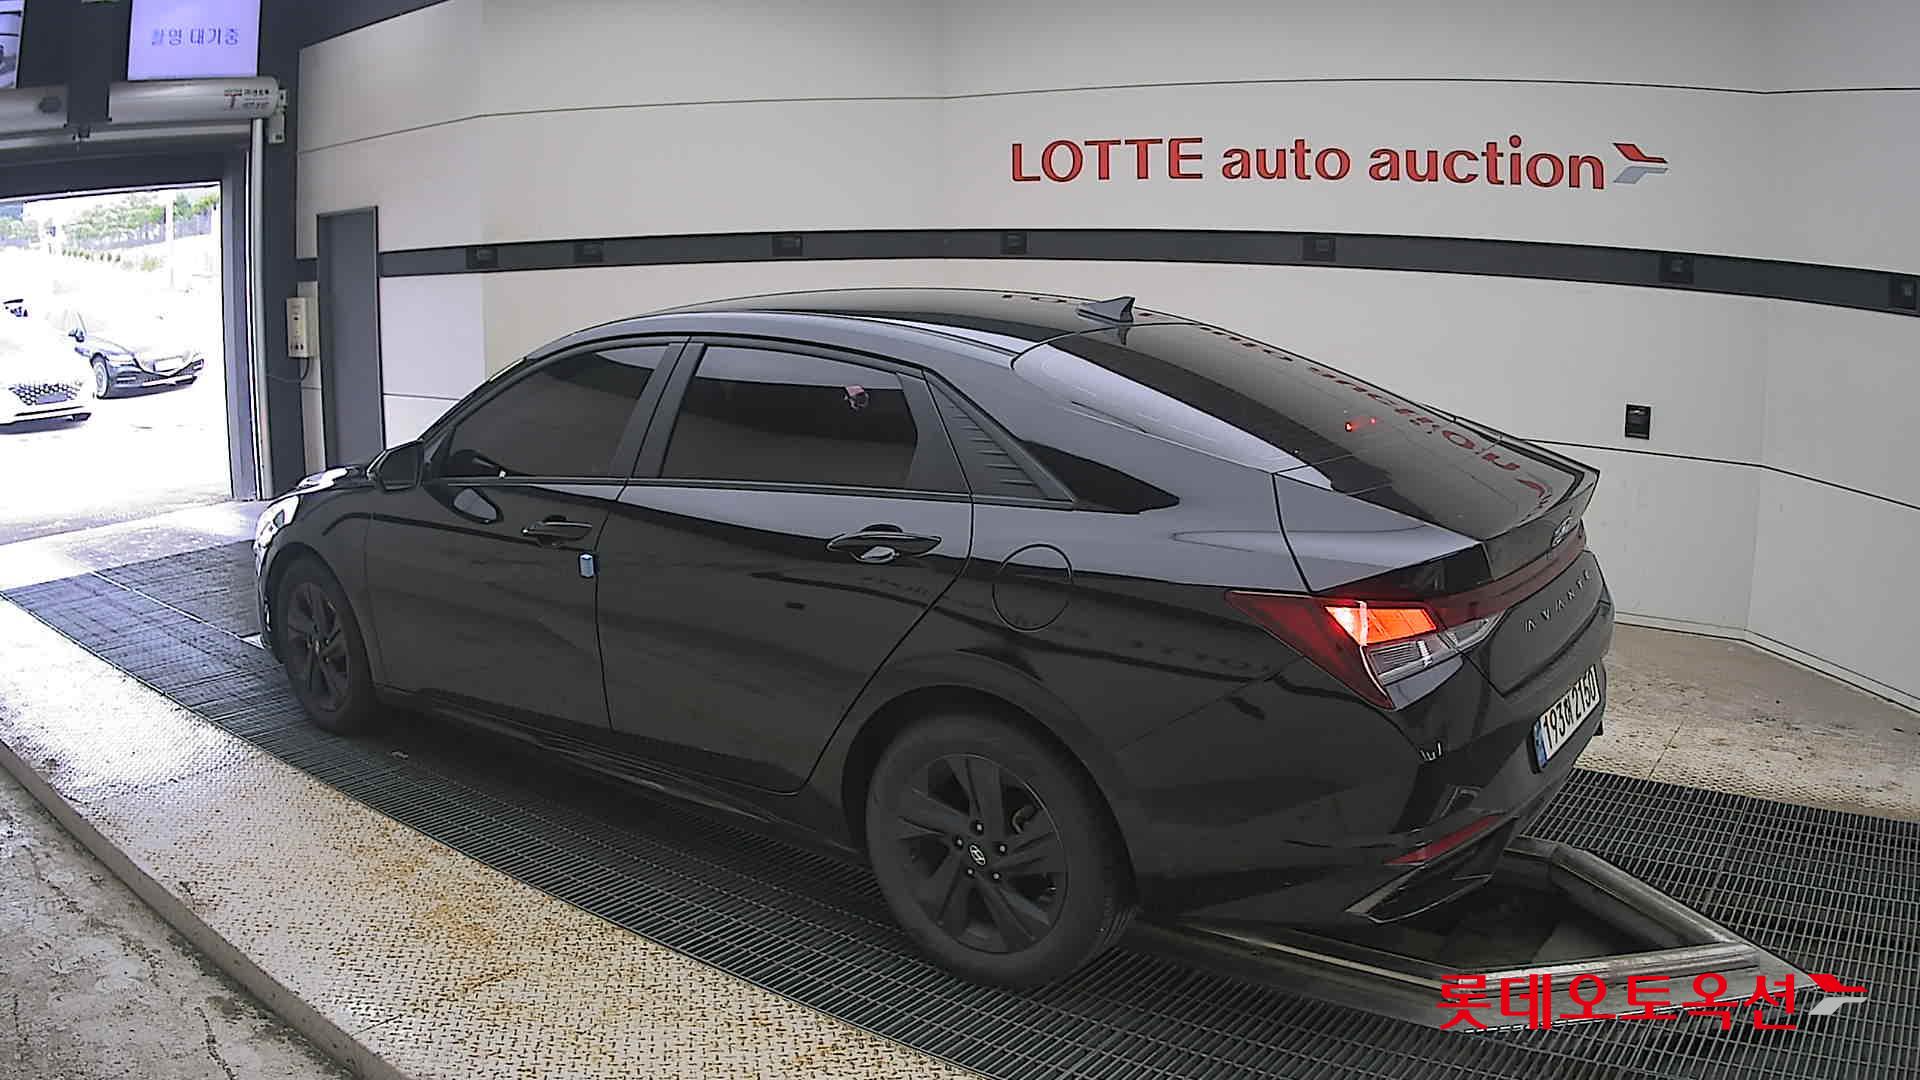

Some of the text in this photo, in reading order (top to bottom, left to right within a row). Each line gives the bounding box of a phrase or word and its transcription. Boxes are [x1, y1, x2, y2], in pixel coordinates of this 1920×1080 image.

[1012, 135, 1605, 189] LOTTE auto auction
